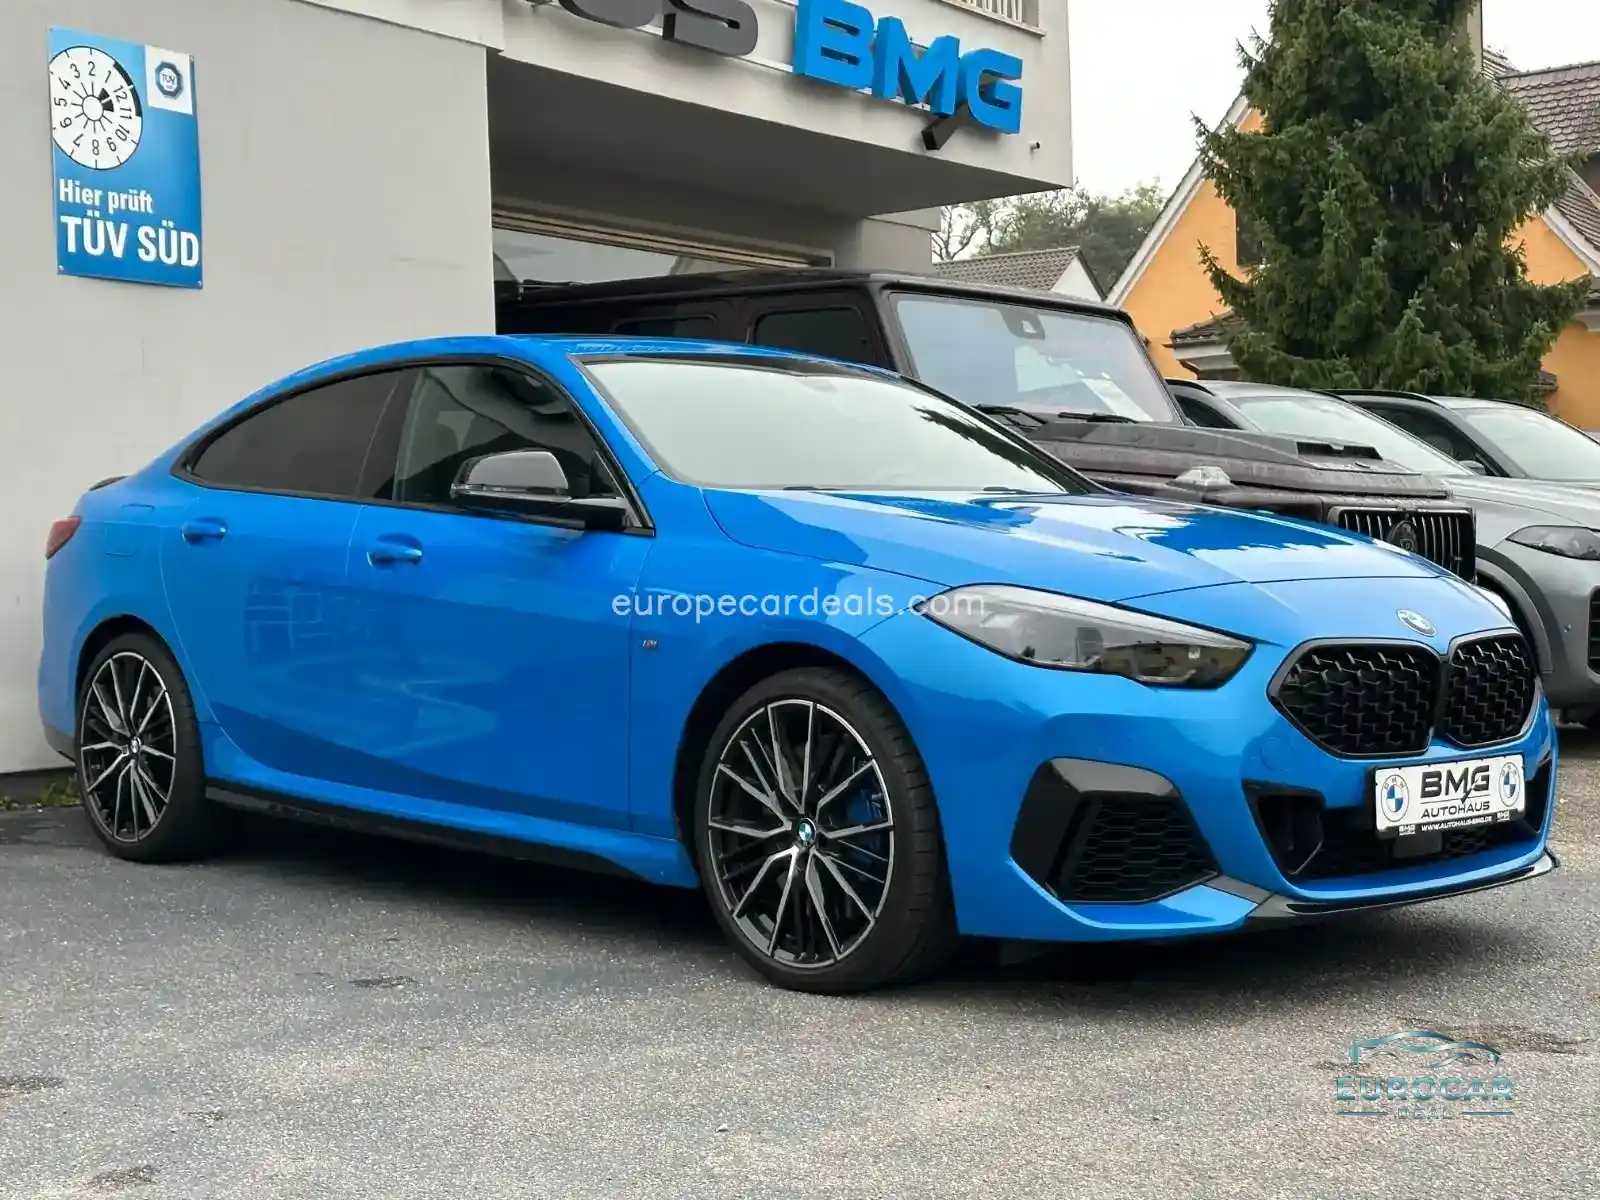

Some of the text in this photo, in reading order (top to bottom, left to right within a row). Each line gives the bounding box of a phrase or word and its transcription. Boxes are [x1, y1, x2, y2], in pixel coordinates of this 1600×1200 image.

[70, 63, 80, 79] 3
[88, 61, 95, 76] 2
[794, 0, 1023, 134] BMG
[58, 77, 71, 90] 4
[105, 70, 111, 83] 1
[54, 97, 67, 107] 5
[113, 85, 128, 102] 12
[119, 107, 132, 120] 11
[73, 133, 84, 147] 7
[115, 123, 130, 142] 10
[92, 139, 100, 156] 8
[59, 178, 153, 214] Hier prüft
[60, 210, 200, 267] TÜV SÜD
[1420, 765, 1490, 800] BMG
[1421, 801, 1490, 819] AUTOHAUS
